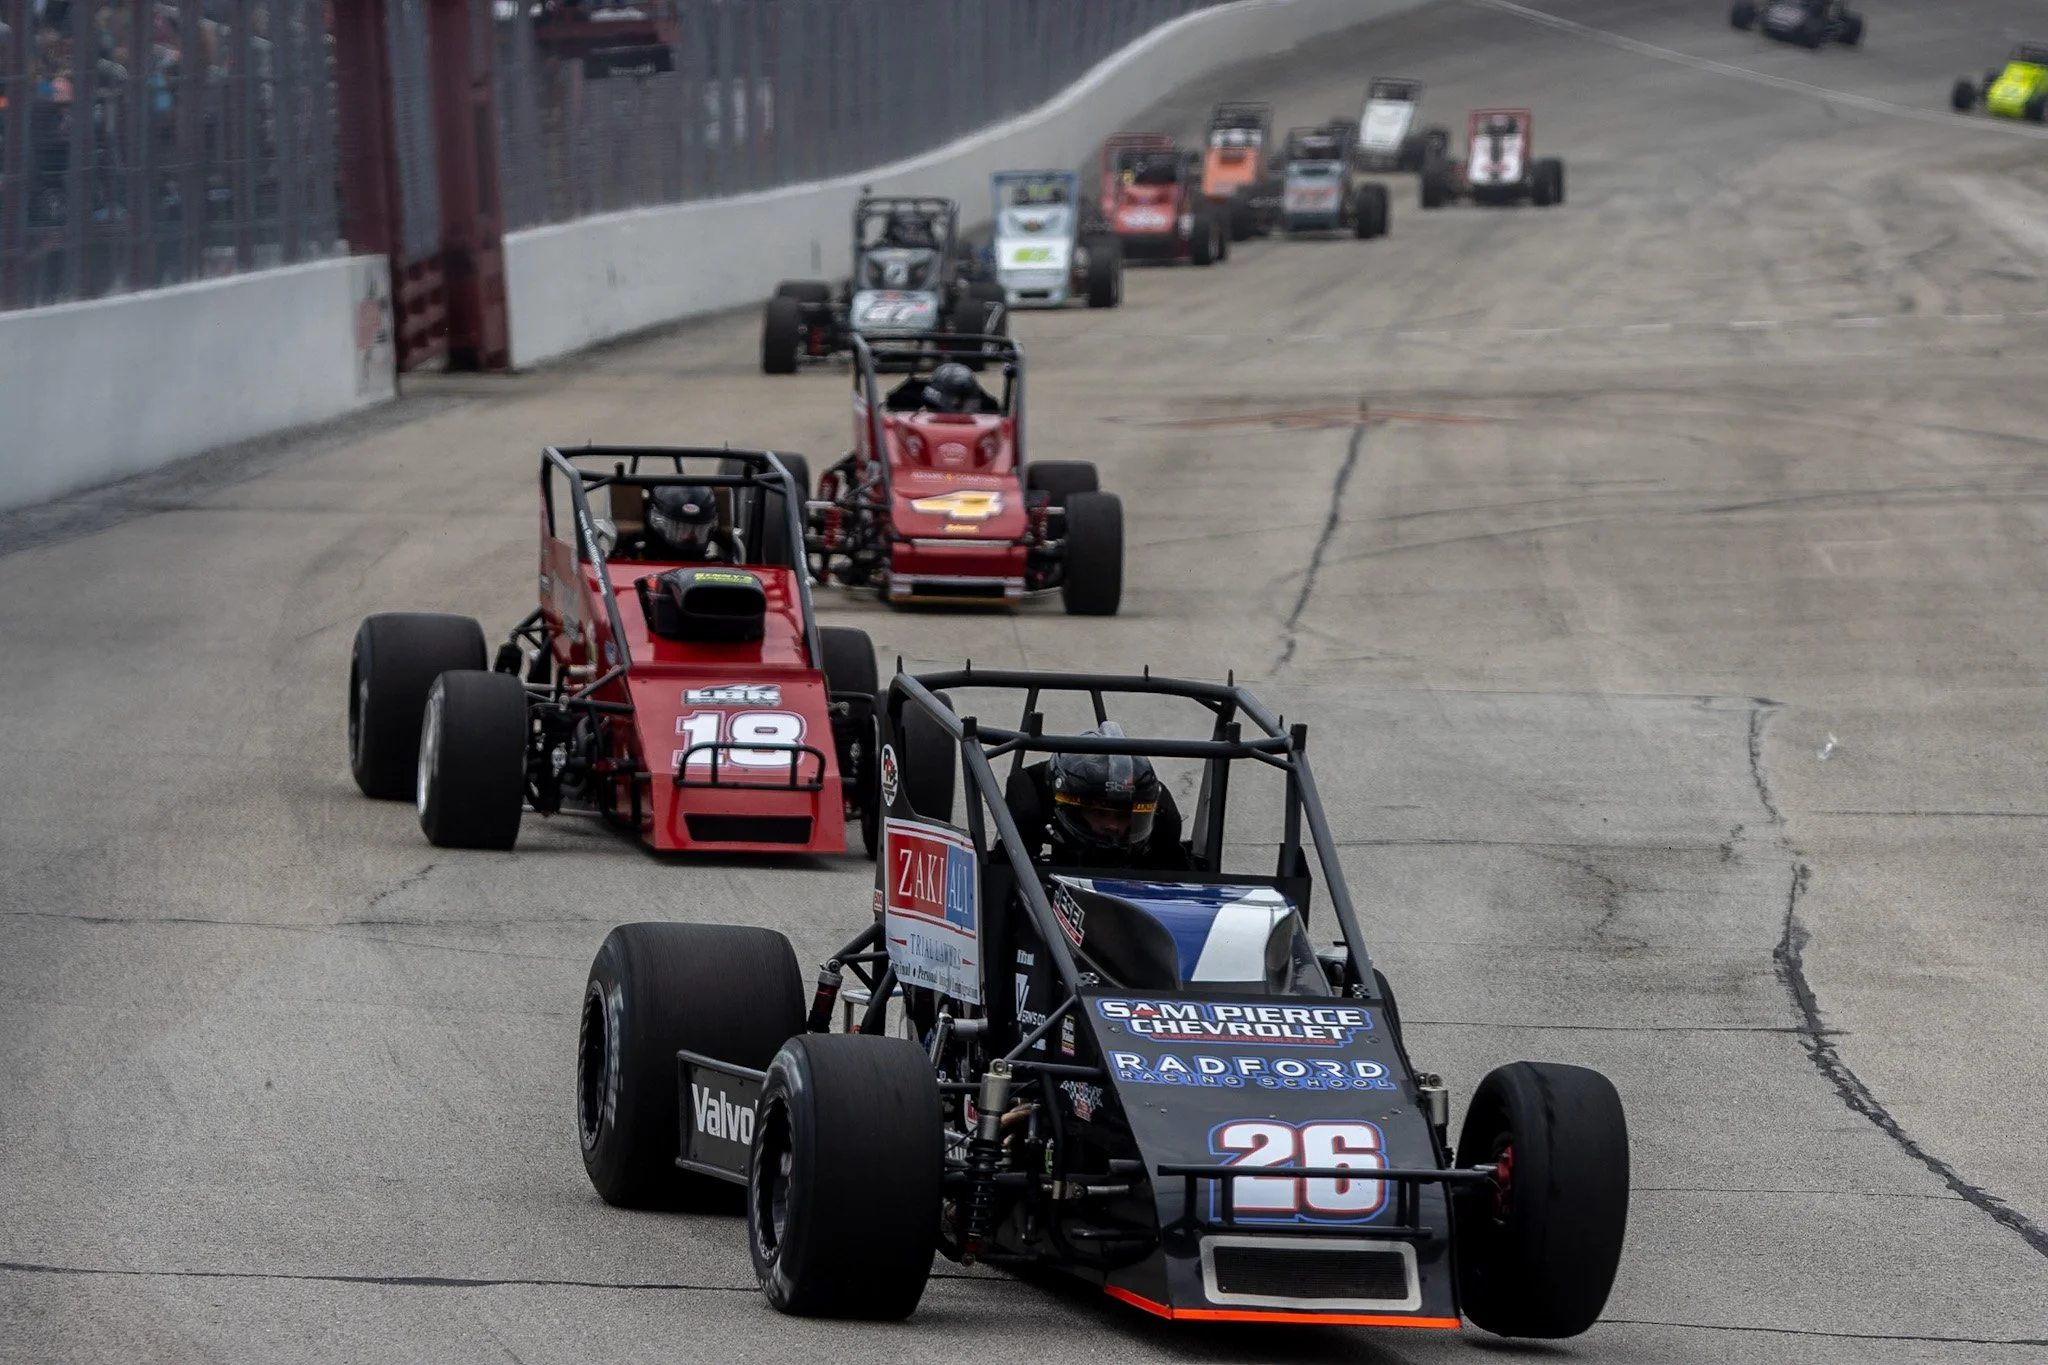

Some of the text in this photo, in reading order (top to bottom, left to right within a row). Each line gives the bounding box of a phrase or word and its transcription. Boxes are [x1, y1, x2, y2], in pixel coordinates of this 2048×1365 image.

[673, 711, 806, 767] 18
[898, 848, 945, 906] ZAKI
[948, 859, 969, 915] ALI
[910, 932, 934, 960] TRIAL
[1101, 1000, 1364, 1027] SAM PIERCE
[1131, 1019, 1346, 1040] CHEVROLET
[1114, 1052, 1384, 1079] RADFORD
[1120, 1070, 1397, 1089] RACING SCHOOL
[691, 1082, 759, 1146] Valvo
[1212, 1119, 1388, 1220] 26
